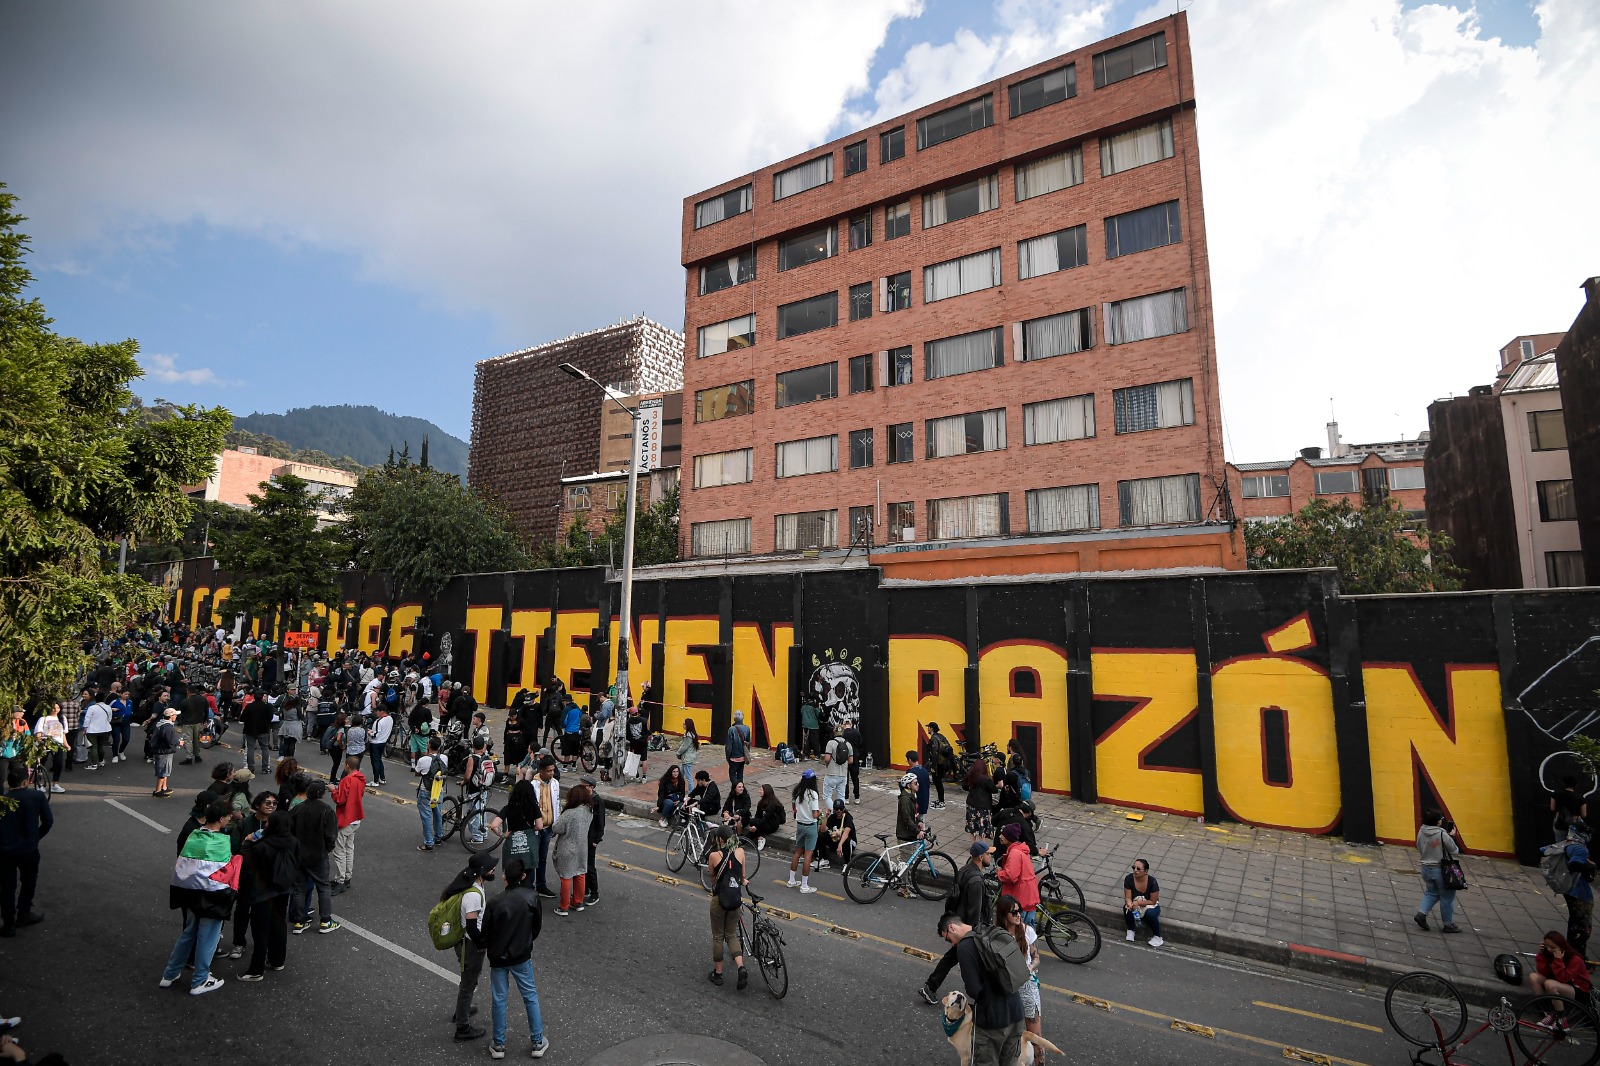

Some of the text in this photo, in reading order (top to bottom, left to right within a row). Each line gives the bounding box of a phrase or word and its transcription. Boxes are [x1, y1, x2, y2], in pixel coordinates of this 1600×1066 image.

[811, 647, 863, 672] 6402
[464, 604, 795, 750] TIENEN
[888, 609, 1516, 859] RAZÓN
